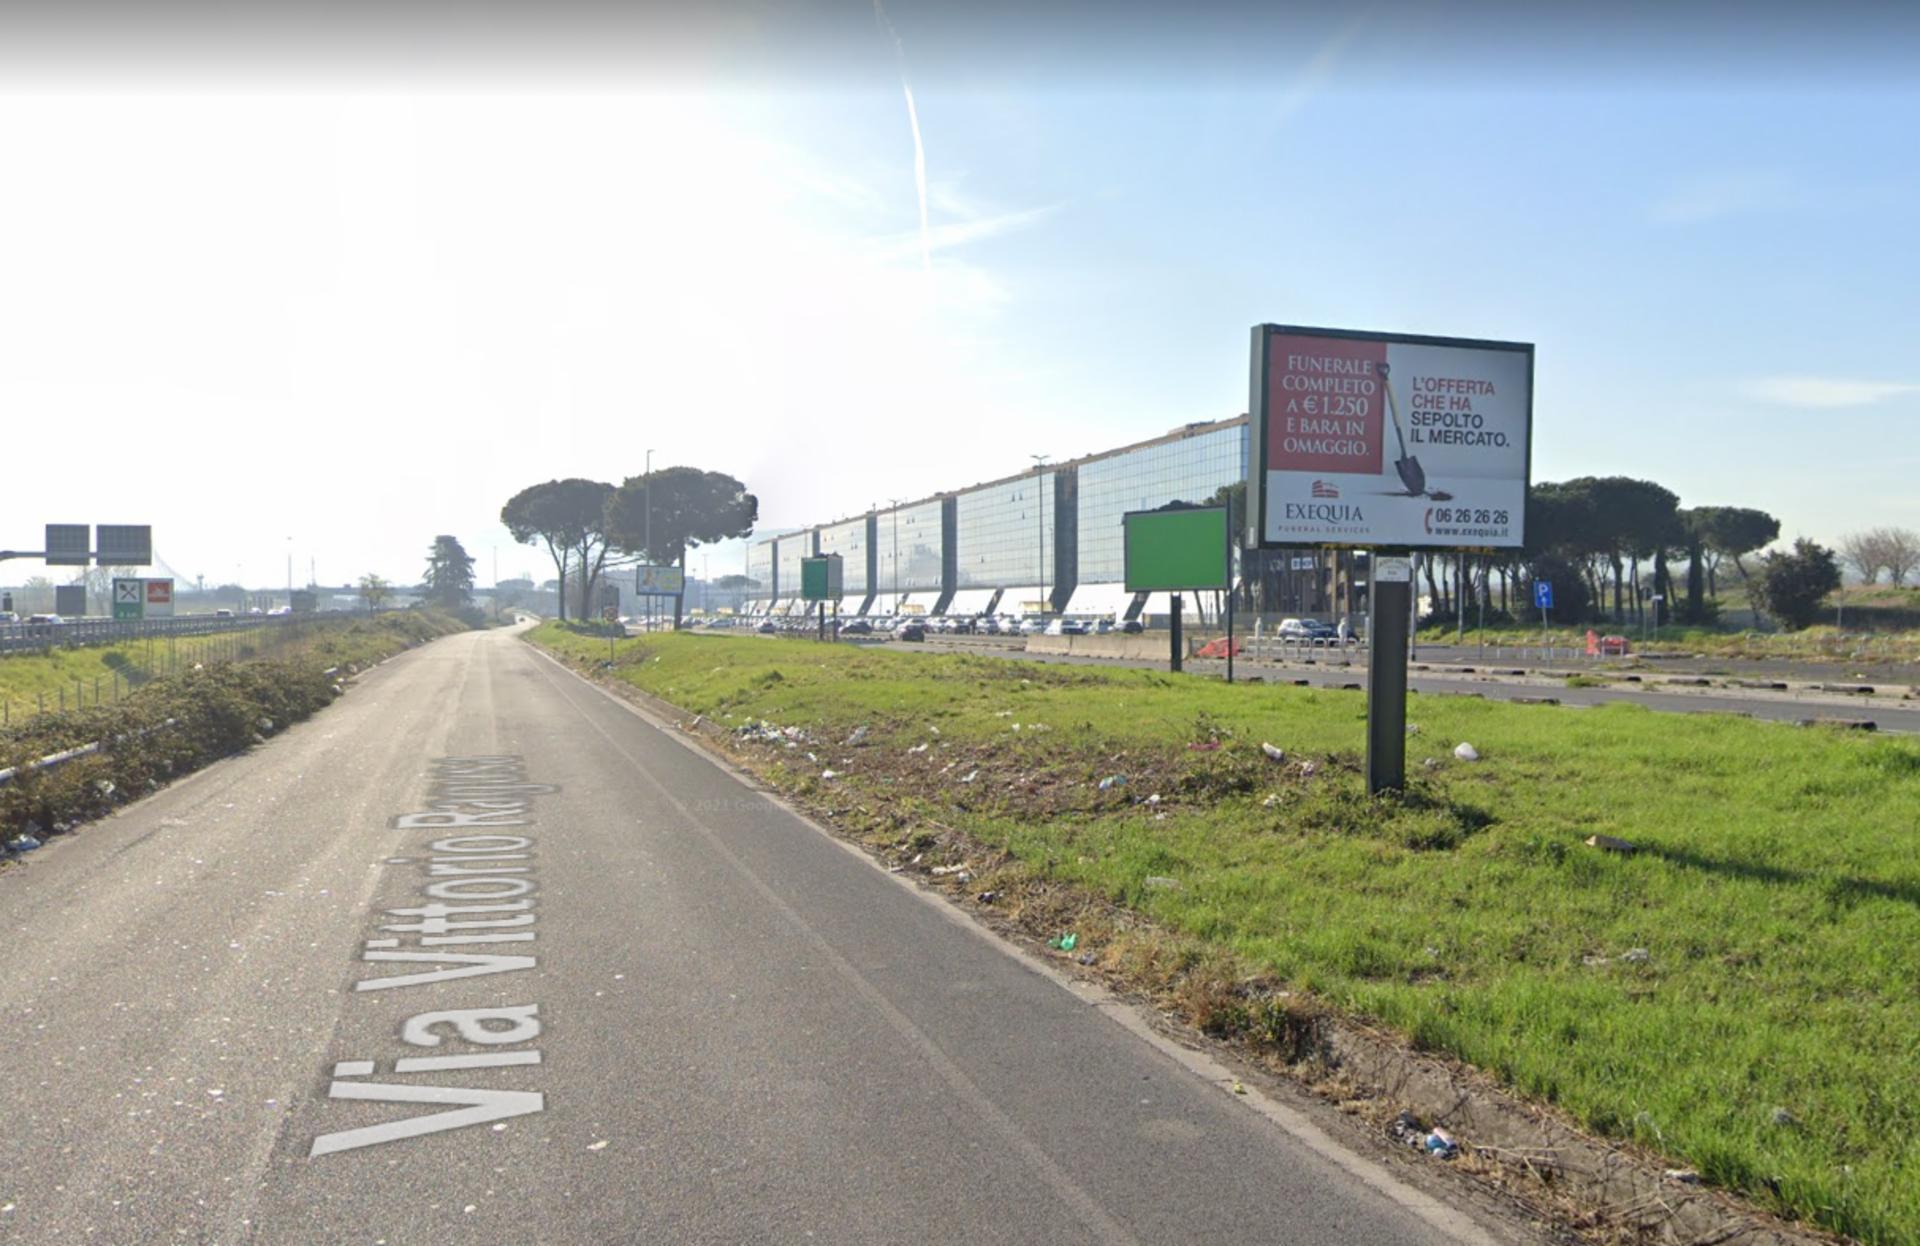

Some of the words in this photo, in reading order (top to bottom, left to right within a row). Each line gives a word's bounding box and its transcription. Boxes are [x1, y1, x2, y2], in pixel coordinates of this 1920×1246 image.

[1287, 355, 1372, 375] FUNERALE
[1282, 375, 1375, 396] COMPLETO
[1412, 376, 1495, 396] L'OFFERTA
[1287, 398, 1299, 413] A
[1411, 393, 1446, 411] CHE
[1450, 396, 1472, 411] HA
[1286, 417, 1297, 433] E
[1300, 418, 1341, 435] BARA
[1346, 420, 1365, 436] IN
[1411, 411, 1484, 429] SEPOLTO
[1283, 437, 1370, 456] OMAGGIO.
[1410, 428, 1424, 443] IL
[1429, 429, 1510, 447] MERCATO.
[1285, 503, 1363, 525] EXEQUIA
[1435, 507, 1453, 523] 06
[1455, 508, 1472, 523] 26
[1474, 509, 1491, 524] 26
[1493, 510, 1509, 525] 26
[1435, 527, 1509, 538] www.exequia.it
[1538, 583, 1549, 597] P
